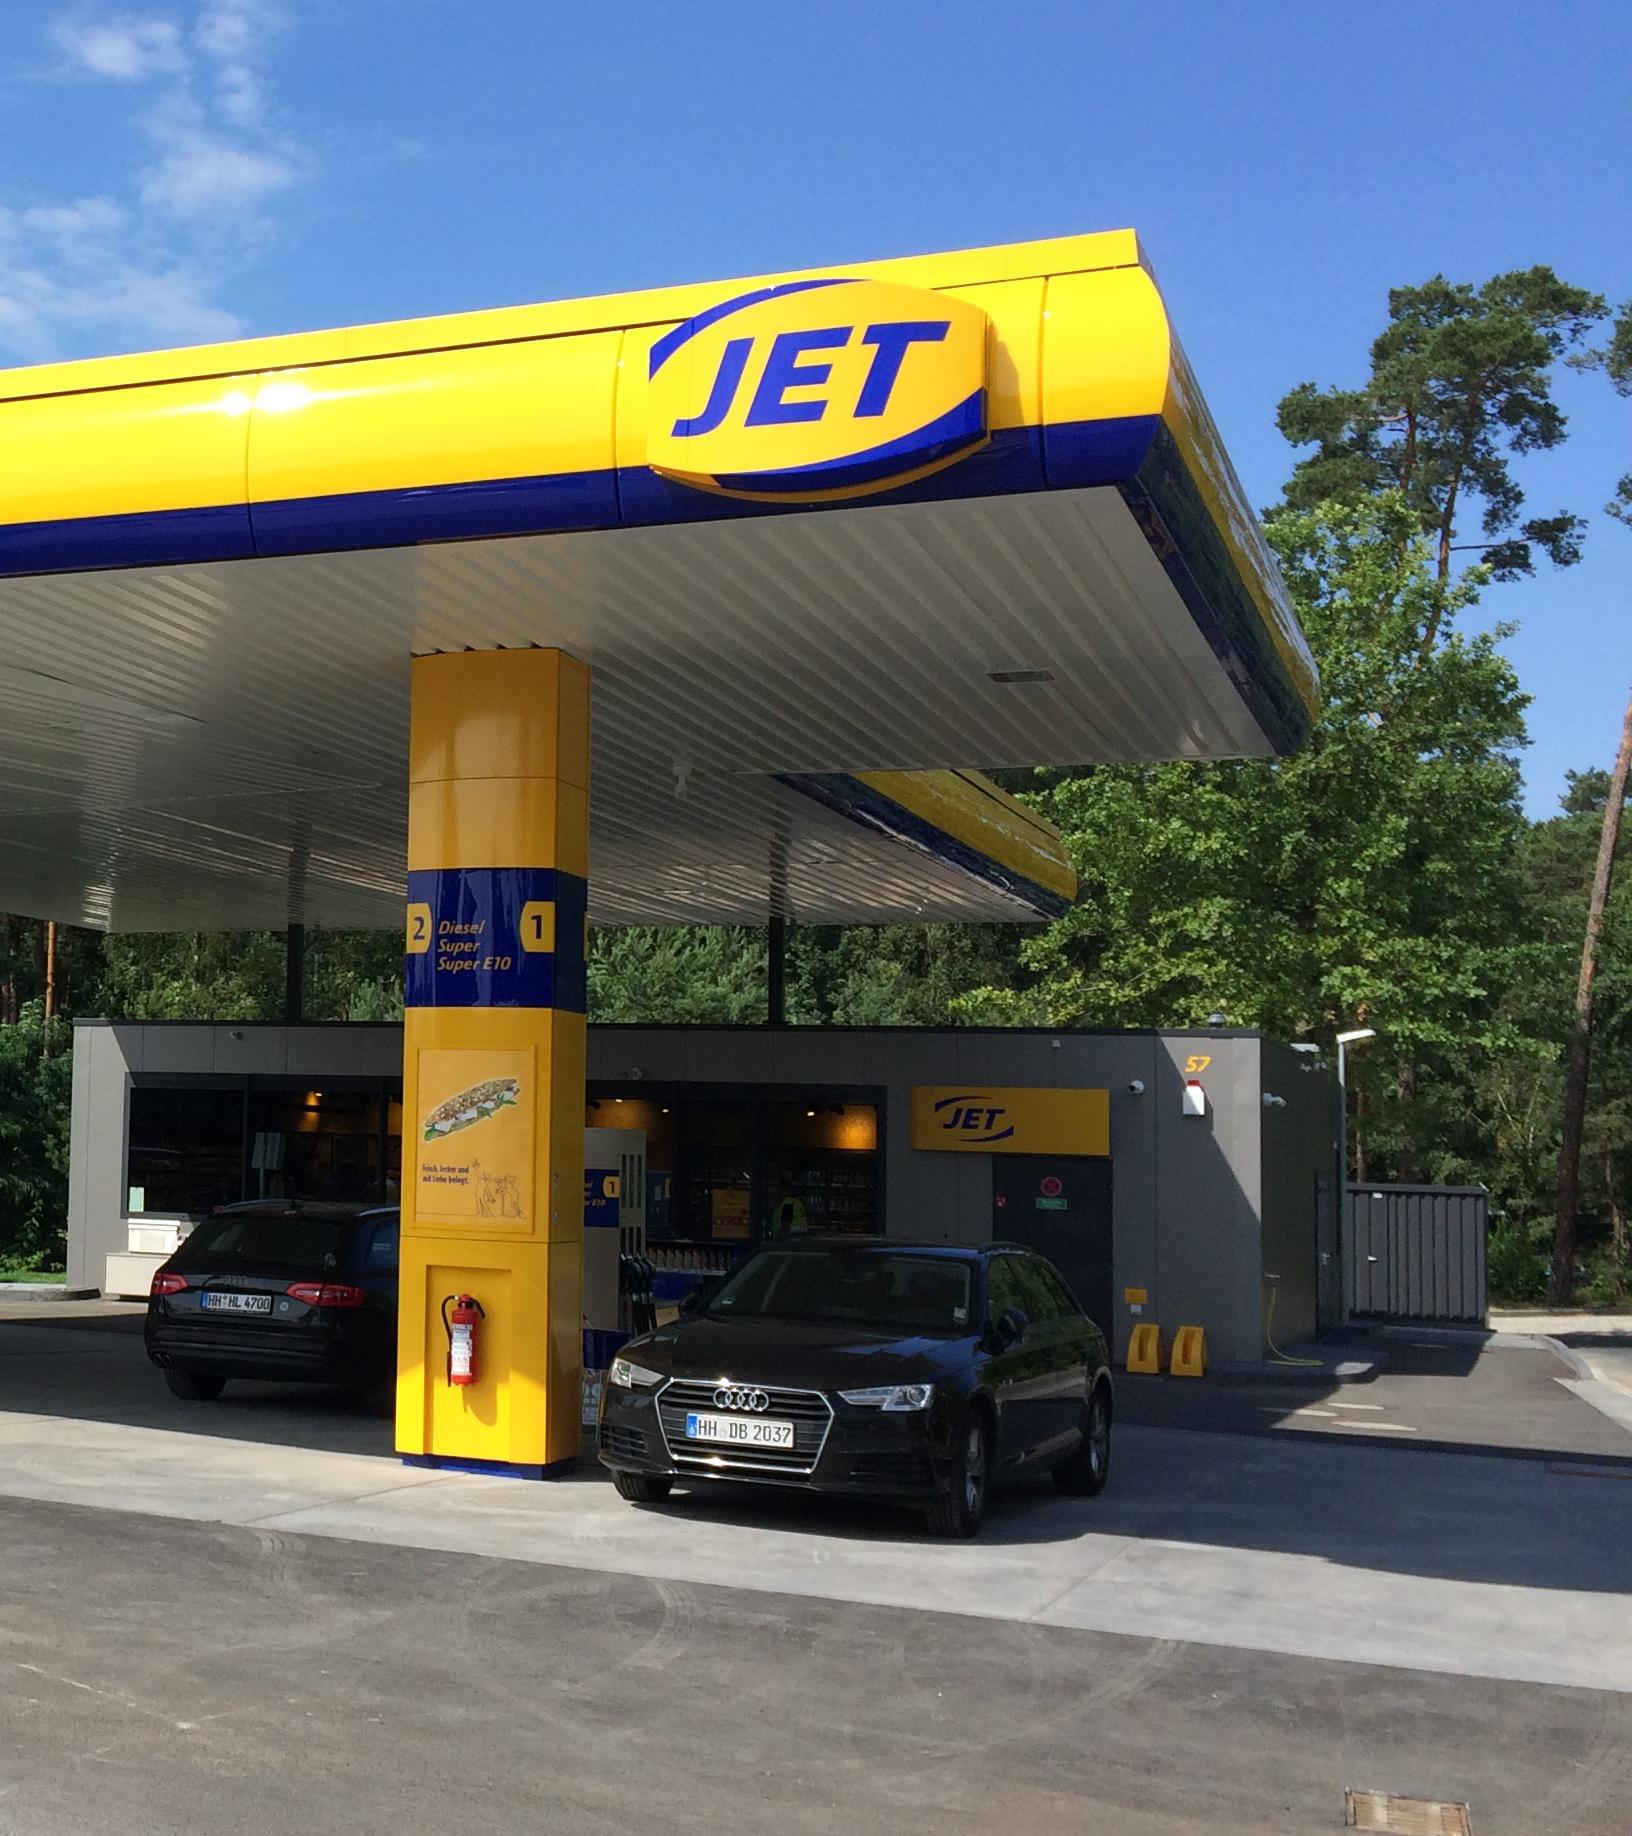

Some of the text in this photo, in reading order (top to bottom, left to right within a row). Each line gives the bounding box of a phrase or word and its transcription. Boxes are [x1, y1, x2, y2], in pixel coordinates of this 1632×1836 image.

[671, 321, 951, 437] JET
[413, 916, 425, 941] 2
[438, 920, 486, 935] Diesel
[530, 914, 543, 940] 1
[437, 939, 481, 954] Super
[437, 957, 512, 974] Super E10
[1184, 1055, 1212, 1073] 57
[943, 1108, 1005, 1130] JET
[608, 1181, 615, 1194] 1
[208, 1294, 270, 1310] HH HL 4700
[698, 1419, 792, 1444] HH DB 2037
